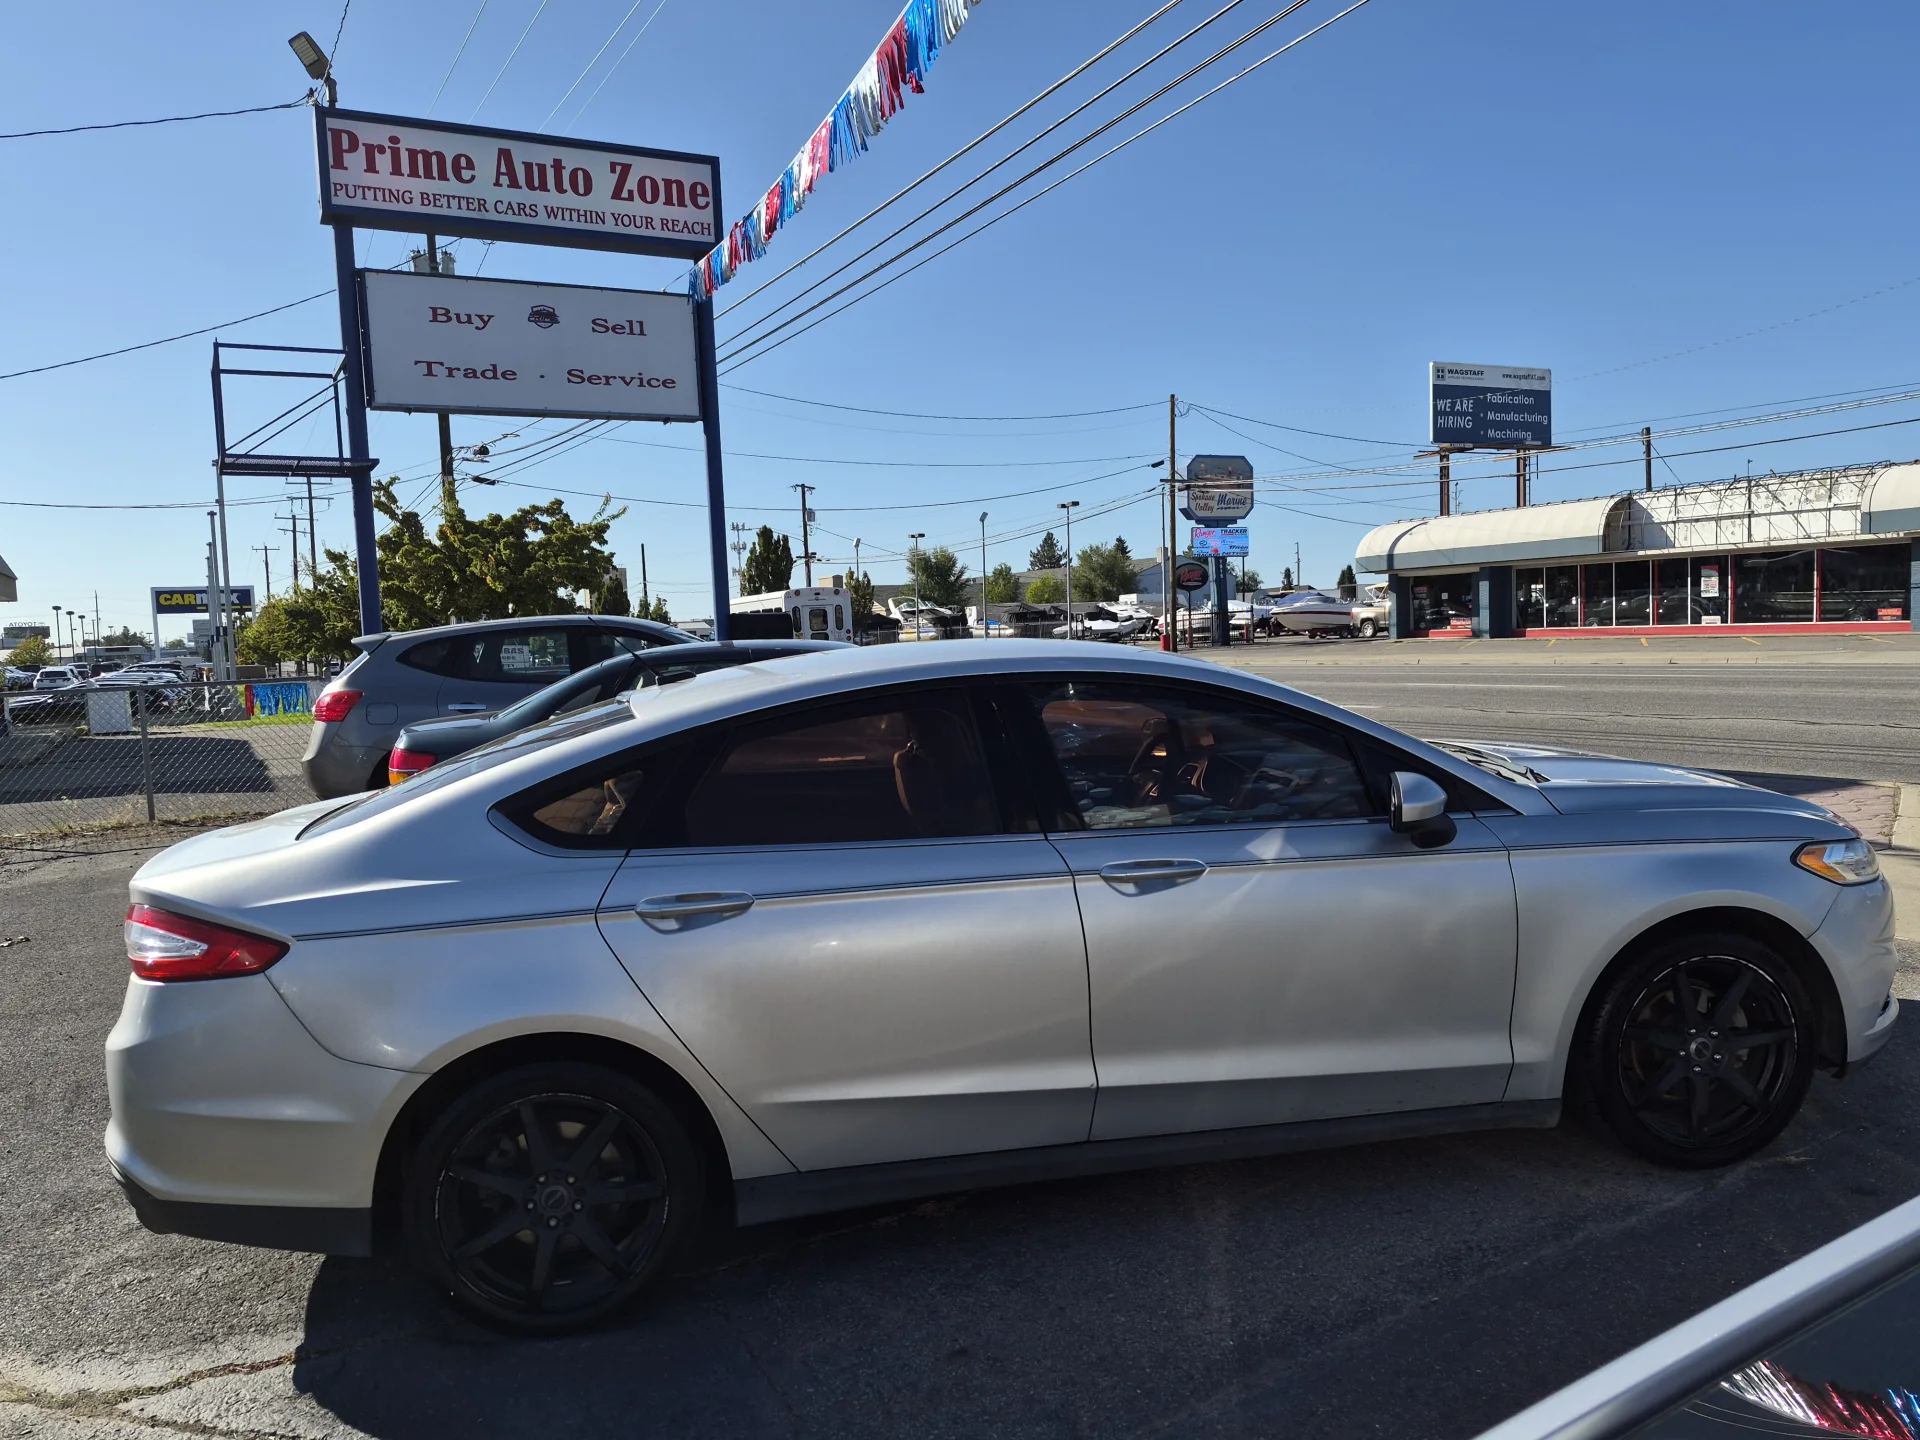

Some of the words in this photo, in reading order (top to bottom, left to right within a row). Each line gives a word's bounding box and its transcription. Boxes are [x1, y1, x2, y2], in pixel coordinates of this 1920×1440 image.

[328, 127, 475, 184] Prime
[493, 148, 593, 197] Auto
[609, 161, 711, 210] Zone
[332, 182, 415, 206] PUTTING
[419, 193, 490, 213] BETTER
[494, 200, 538, 219] CARS
[543, 205, 606, 225] WITHIN
[610, 213, 656, 231] YOUR
[660, 218, 713, 237] REACH
[428, 306, 495, 330] Buy
[591, 318, 647, 336] Sell
[414, 360, 518, 381] Trade
[566, 368, 677, 389] Service
[1447, 368, 1485, 376] WAGSTAFF
[1437, 399, 1451, 412] WE
[1454, 399, 1474, 412] ARE
[1487, 393, 1535, 405] Fabrication
[1437, 416, 1473, 429] HIRING
[1487, 411, 1548, 425] Manufacturing
[1487, 429, 1532, 441] Machining
[1217, 493, 1248, 506] Marine
